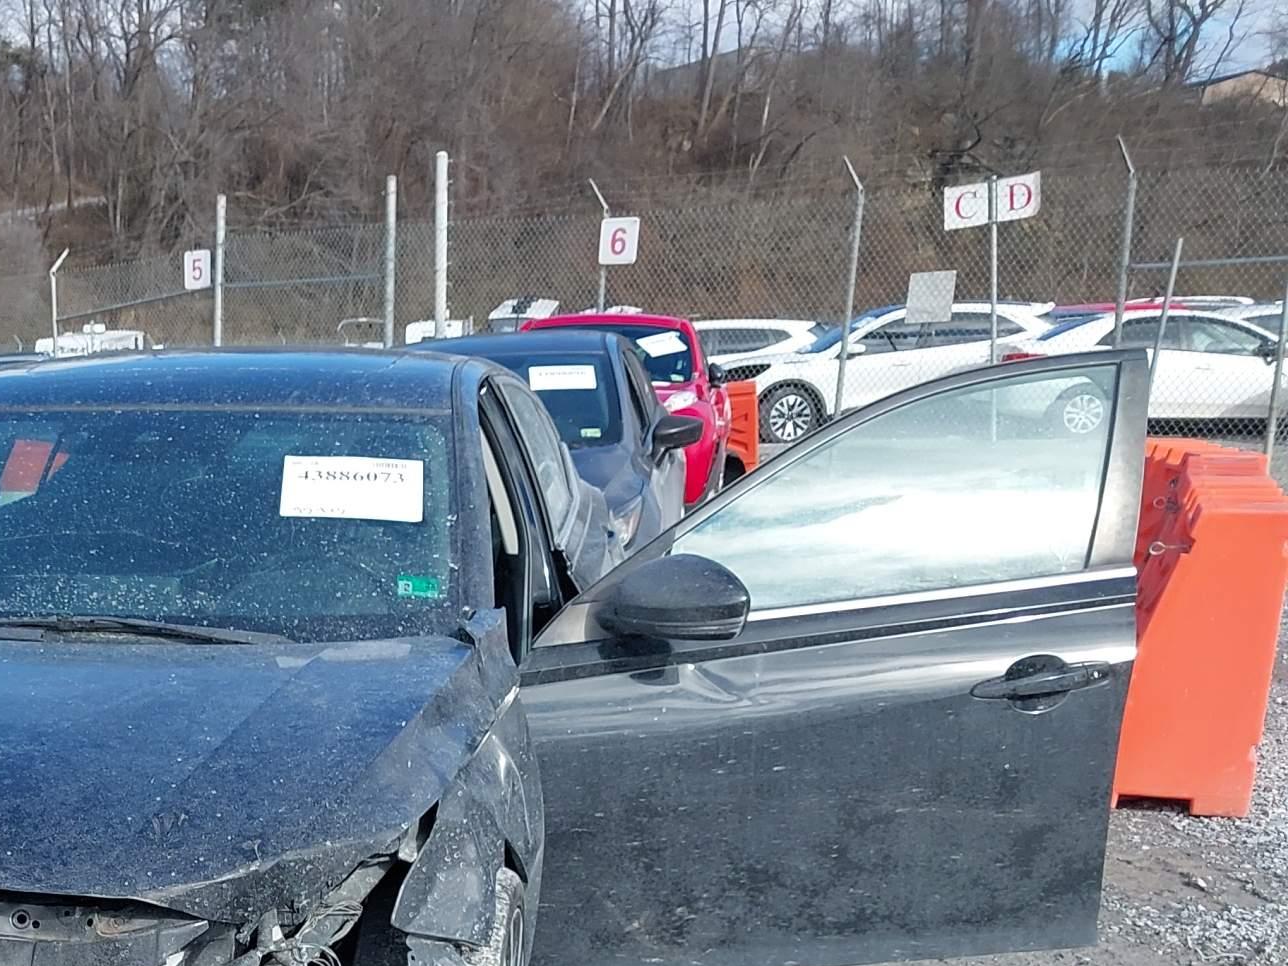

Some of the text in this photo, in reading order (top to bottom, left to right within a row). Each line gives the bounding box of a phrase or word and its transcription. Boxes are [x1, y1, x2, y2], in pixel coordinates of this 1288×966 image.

[955, 191, 977, 220] C
[1008, 182, 1032, 212] D
[610, 227, 627, 255] 6
[192, 258, 202, 281] 5
[297, 470, 406, 484] 43886073
